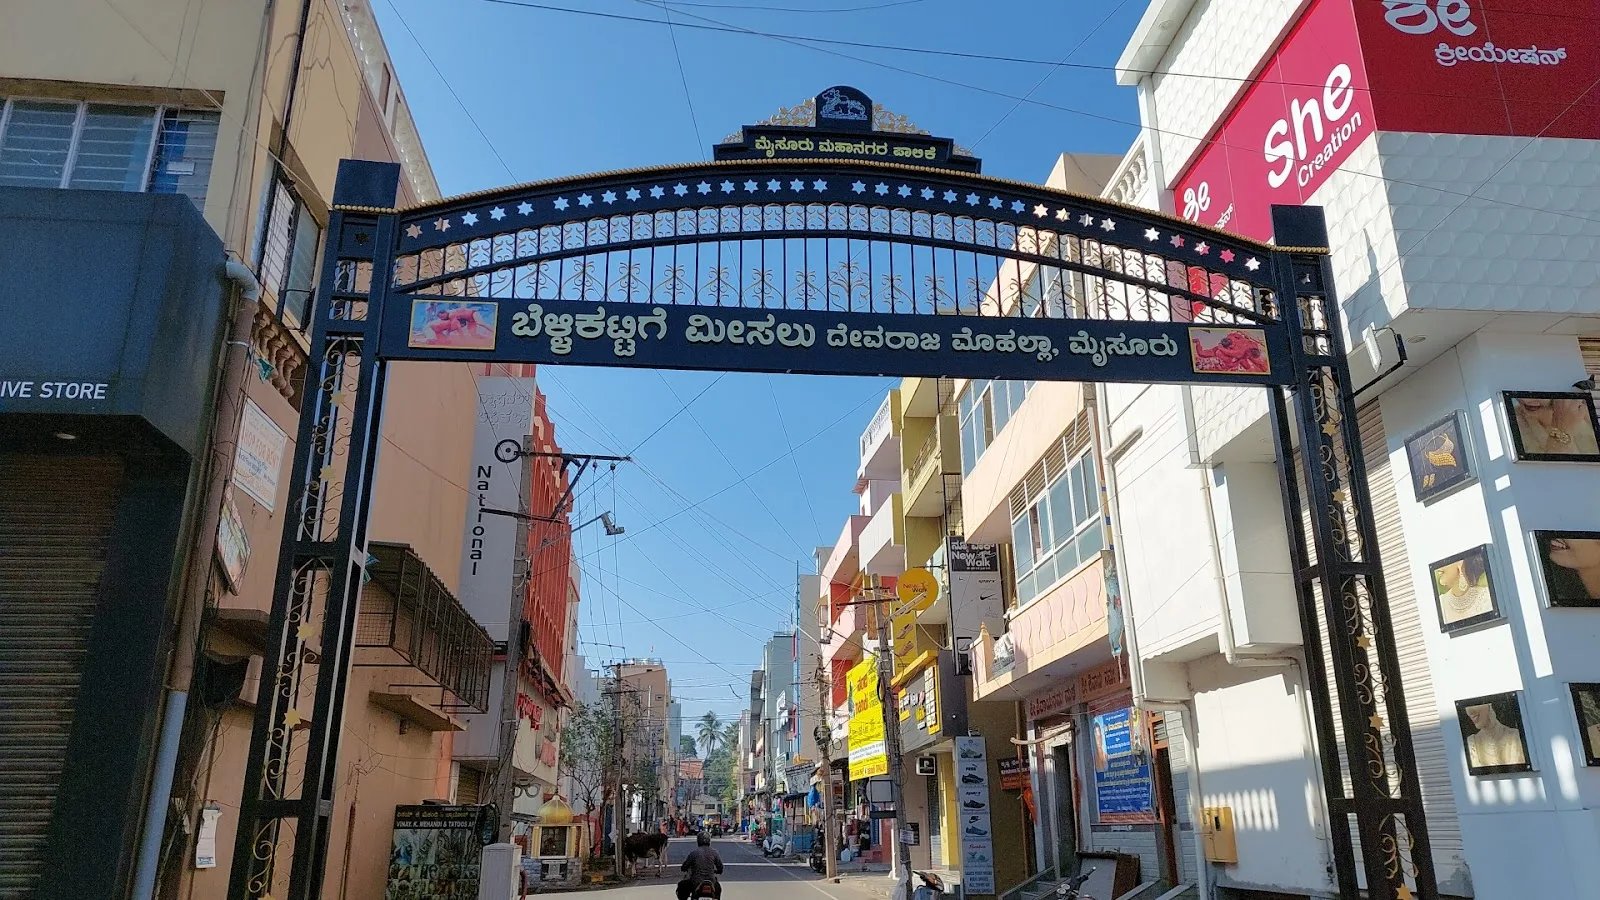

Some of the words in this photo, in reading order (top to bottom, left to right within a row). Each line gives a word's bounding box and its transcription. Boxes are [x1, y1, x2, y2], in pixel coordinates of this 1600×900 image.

[755, 135, 815, 158] ಮೈಸೂರು
[818, 139, 889, 156] ಮಹಾನಗರ
[893, 146, 937, 160] ಪಾಲಿಕೆ
[685, 313, 816, 347] ಮೀಸಲು
[826, 322, 941, 350] ದೇವರಾಜ
[1068, 330, 1179, 367] ಮೈಸೂರು
[0, 381, 34, 398] IVE
[39, 382, 109, 400] STORE
[470, 465, 492, 575] National
[951, 551, 975, 560] New
[965, 558, 990, 567] Walk
